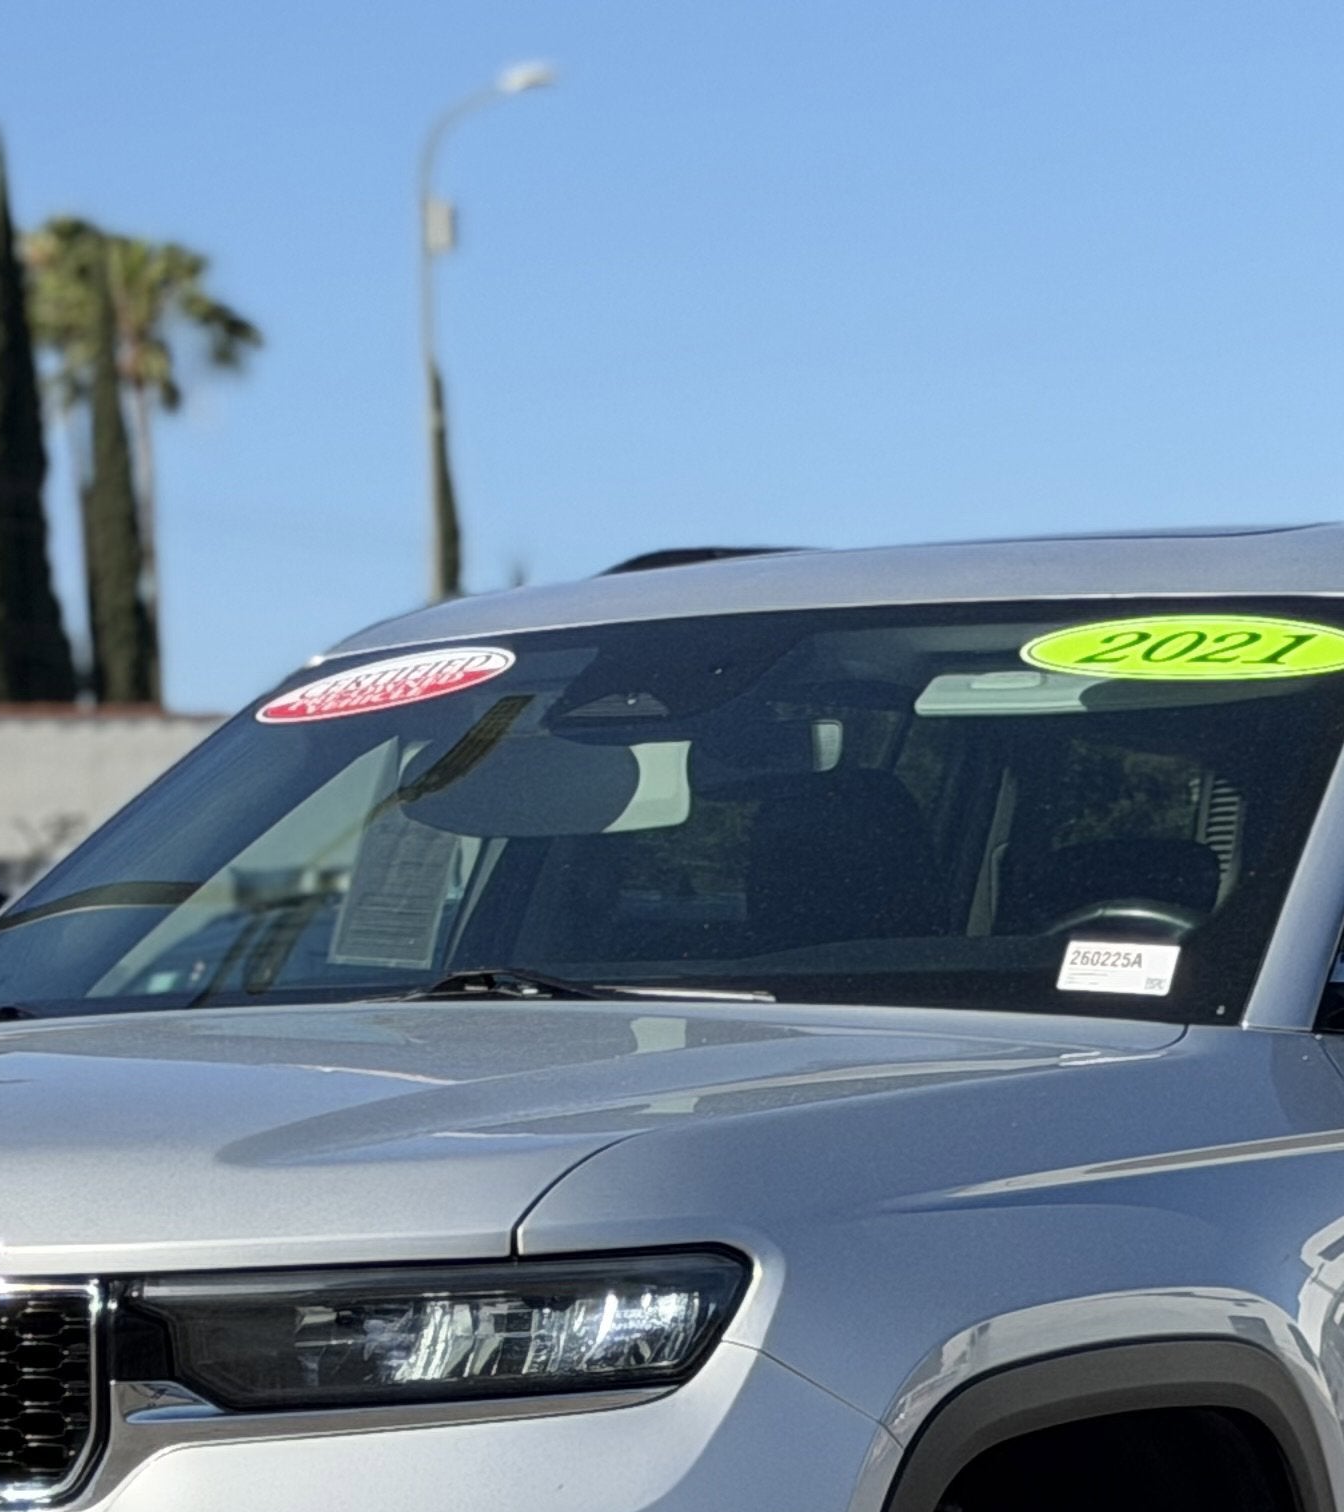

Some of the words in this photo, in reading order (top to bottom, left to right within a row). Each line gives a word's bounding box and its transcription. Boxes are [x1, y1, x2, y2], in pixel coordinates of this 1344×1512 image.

[1072, 630, 1319, 665] 2021
[300, 654, 492, 700] CERTIFIED
[1069, 950, 1143, 969] 260225A
